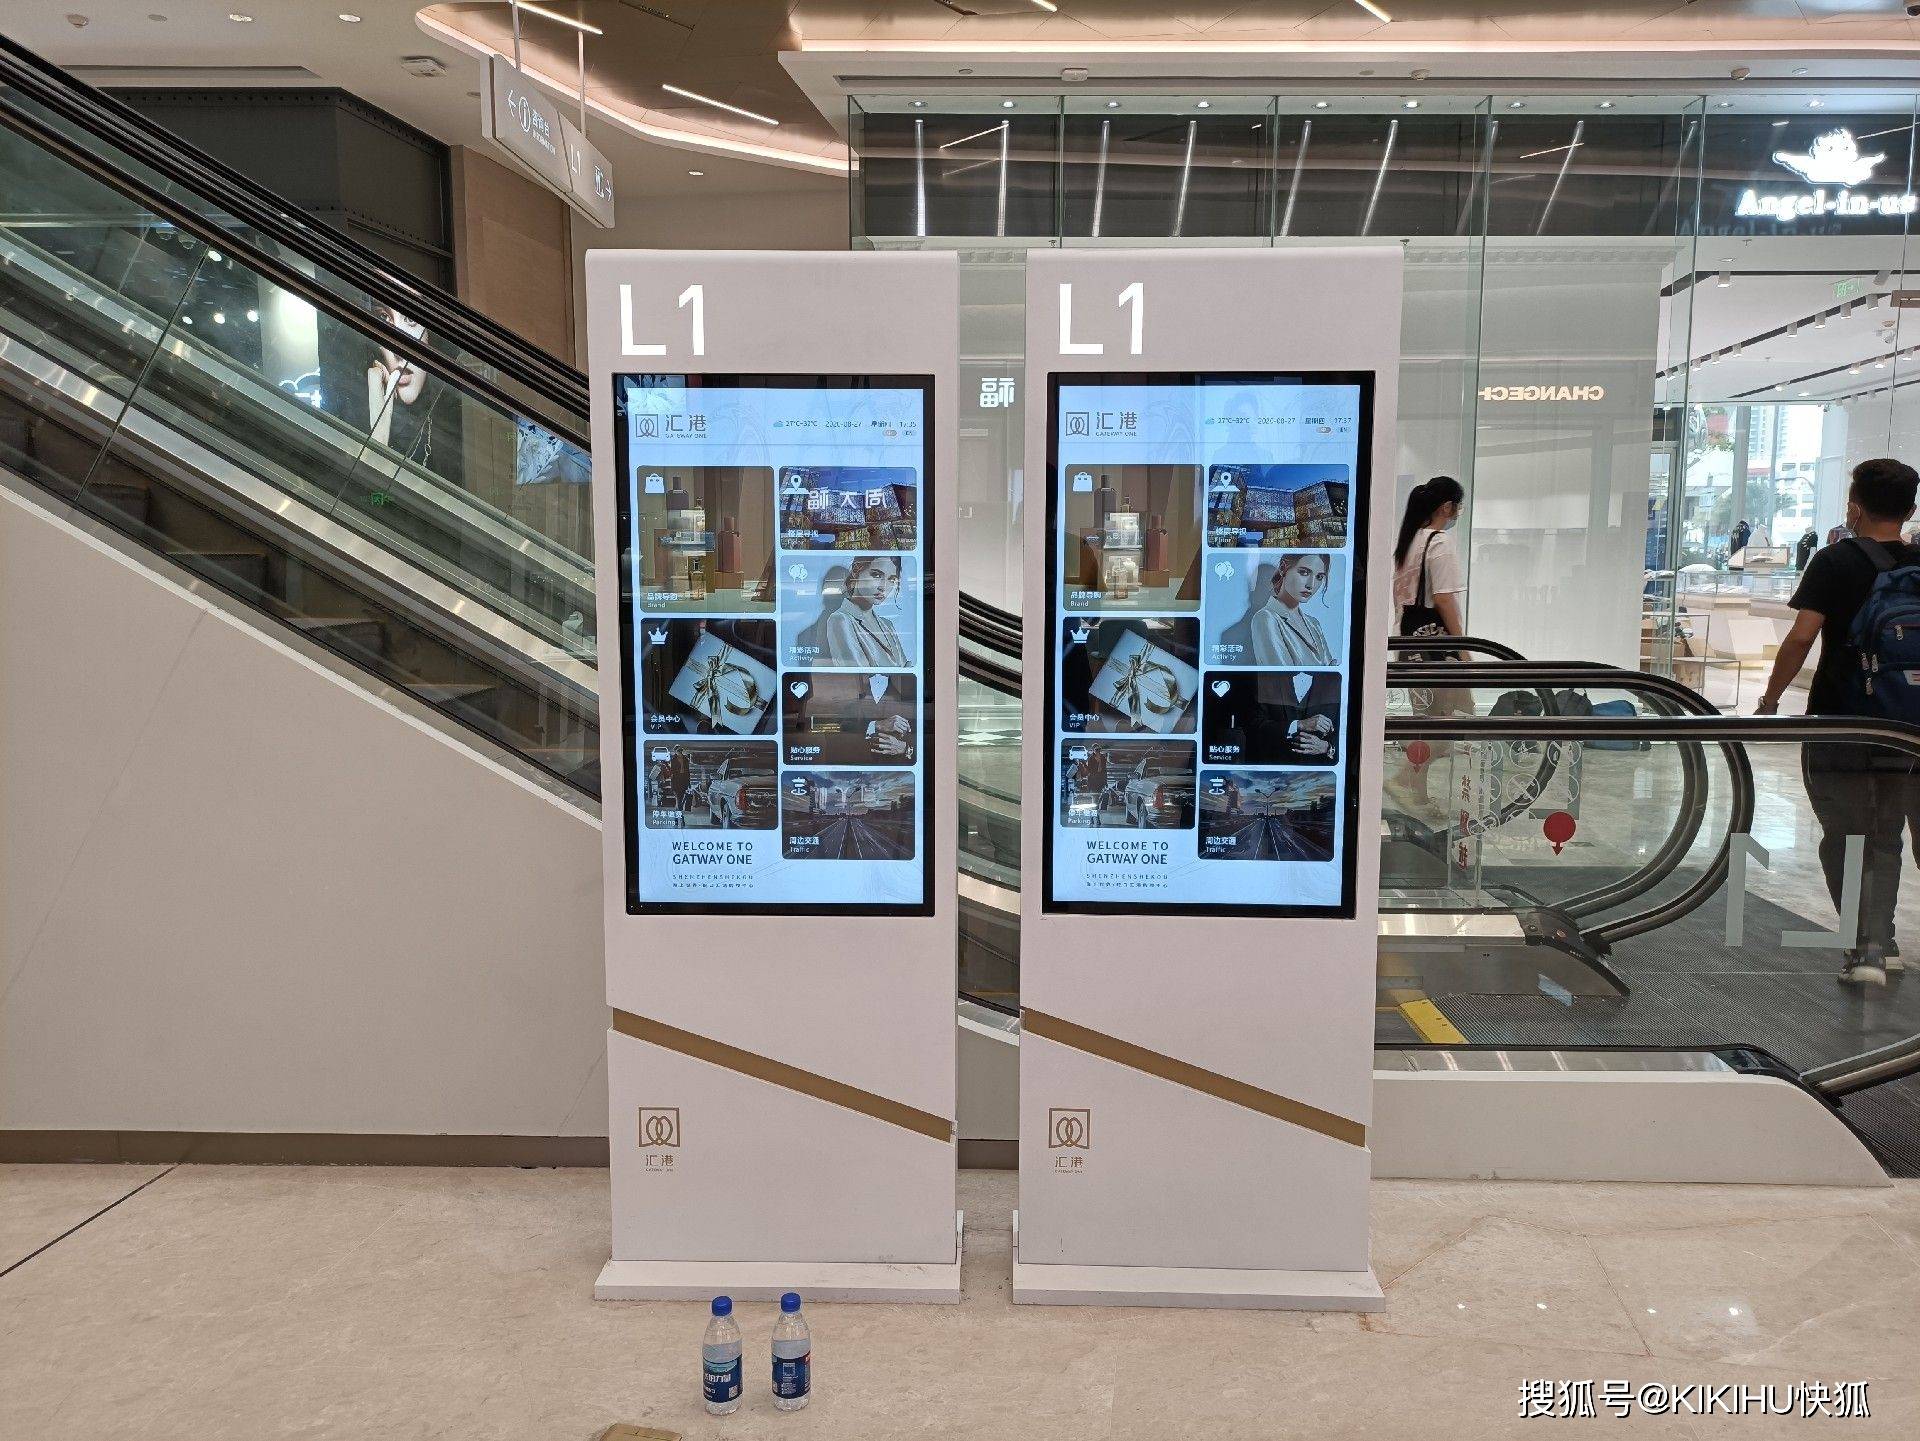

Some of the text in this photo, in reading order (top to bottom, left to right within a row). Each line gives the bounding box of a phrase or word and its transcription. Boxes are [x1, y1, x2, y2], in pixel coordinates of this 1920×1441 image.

[570, 144, 581, 176] L1
[619, 284, 705, 356] L1
[1058, 282, 1145, 355] L1
[665, 414, 707, 432] 汇港
[1096, 411, 1138, 430] 汇港
[672, 841, 753, 851] WELCOME TO
[1086, 840, 1169, 851] WELCOME TO
[672, 853, 753, 865] GATWAY ONE
[1086, 853, 1168, 865] GATWAY ONE
[645, 1154, 674, 1166] 汇港
[1054, 1156, 1084, 1168] 汇港
